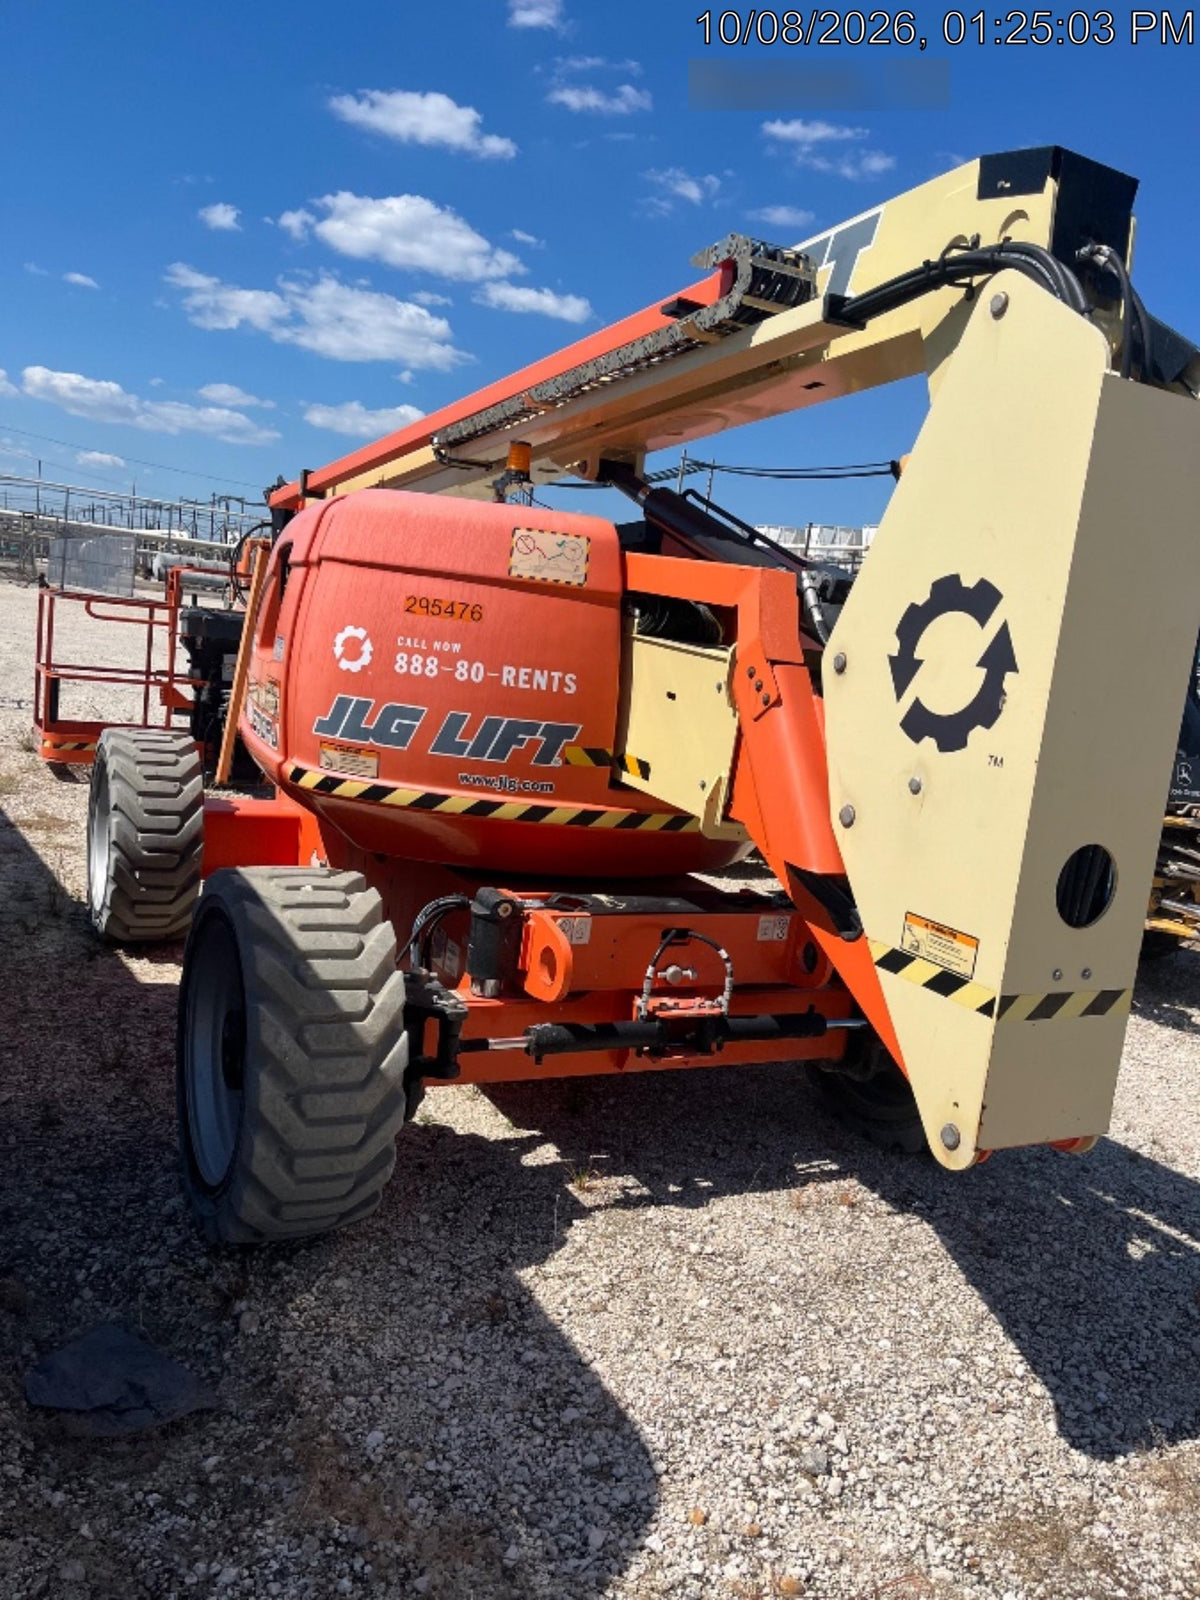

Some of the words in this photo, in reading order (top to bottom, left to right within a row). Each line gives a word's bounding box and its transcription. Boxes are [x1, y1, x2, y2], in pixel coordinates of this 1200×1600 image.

[405, 595, 484, 622] 295476
[397, 636, 428, 650] CALL
[433, 641, 462, 653] NOW
[394, 652, 578, 695] 888-80-RENTS
[312, 693, 428, 751] JLG
[428, 711, 583, 767] LIFT
[458, 773, 555, 792] www.jlg.com
